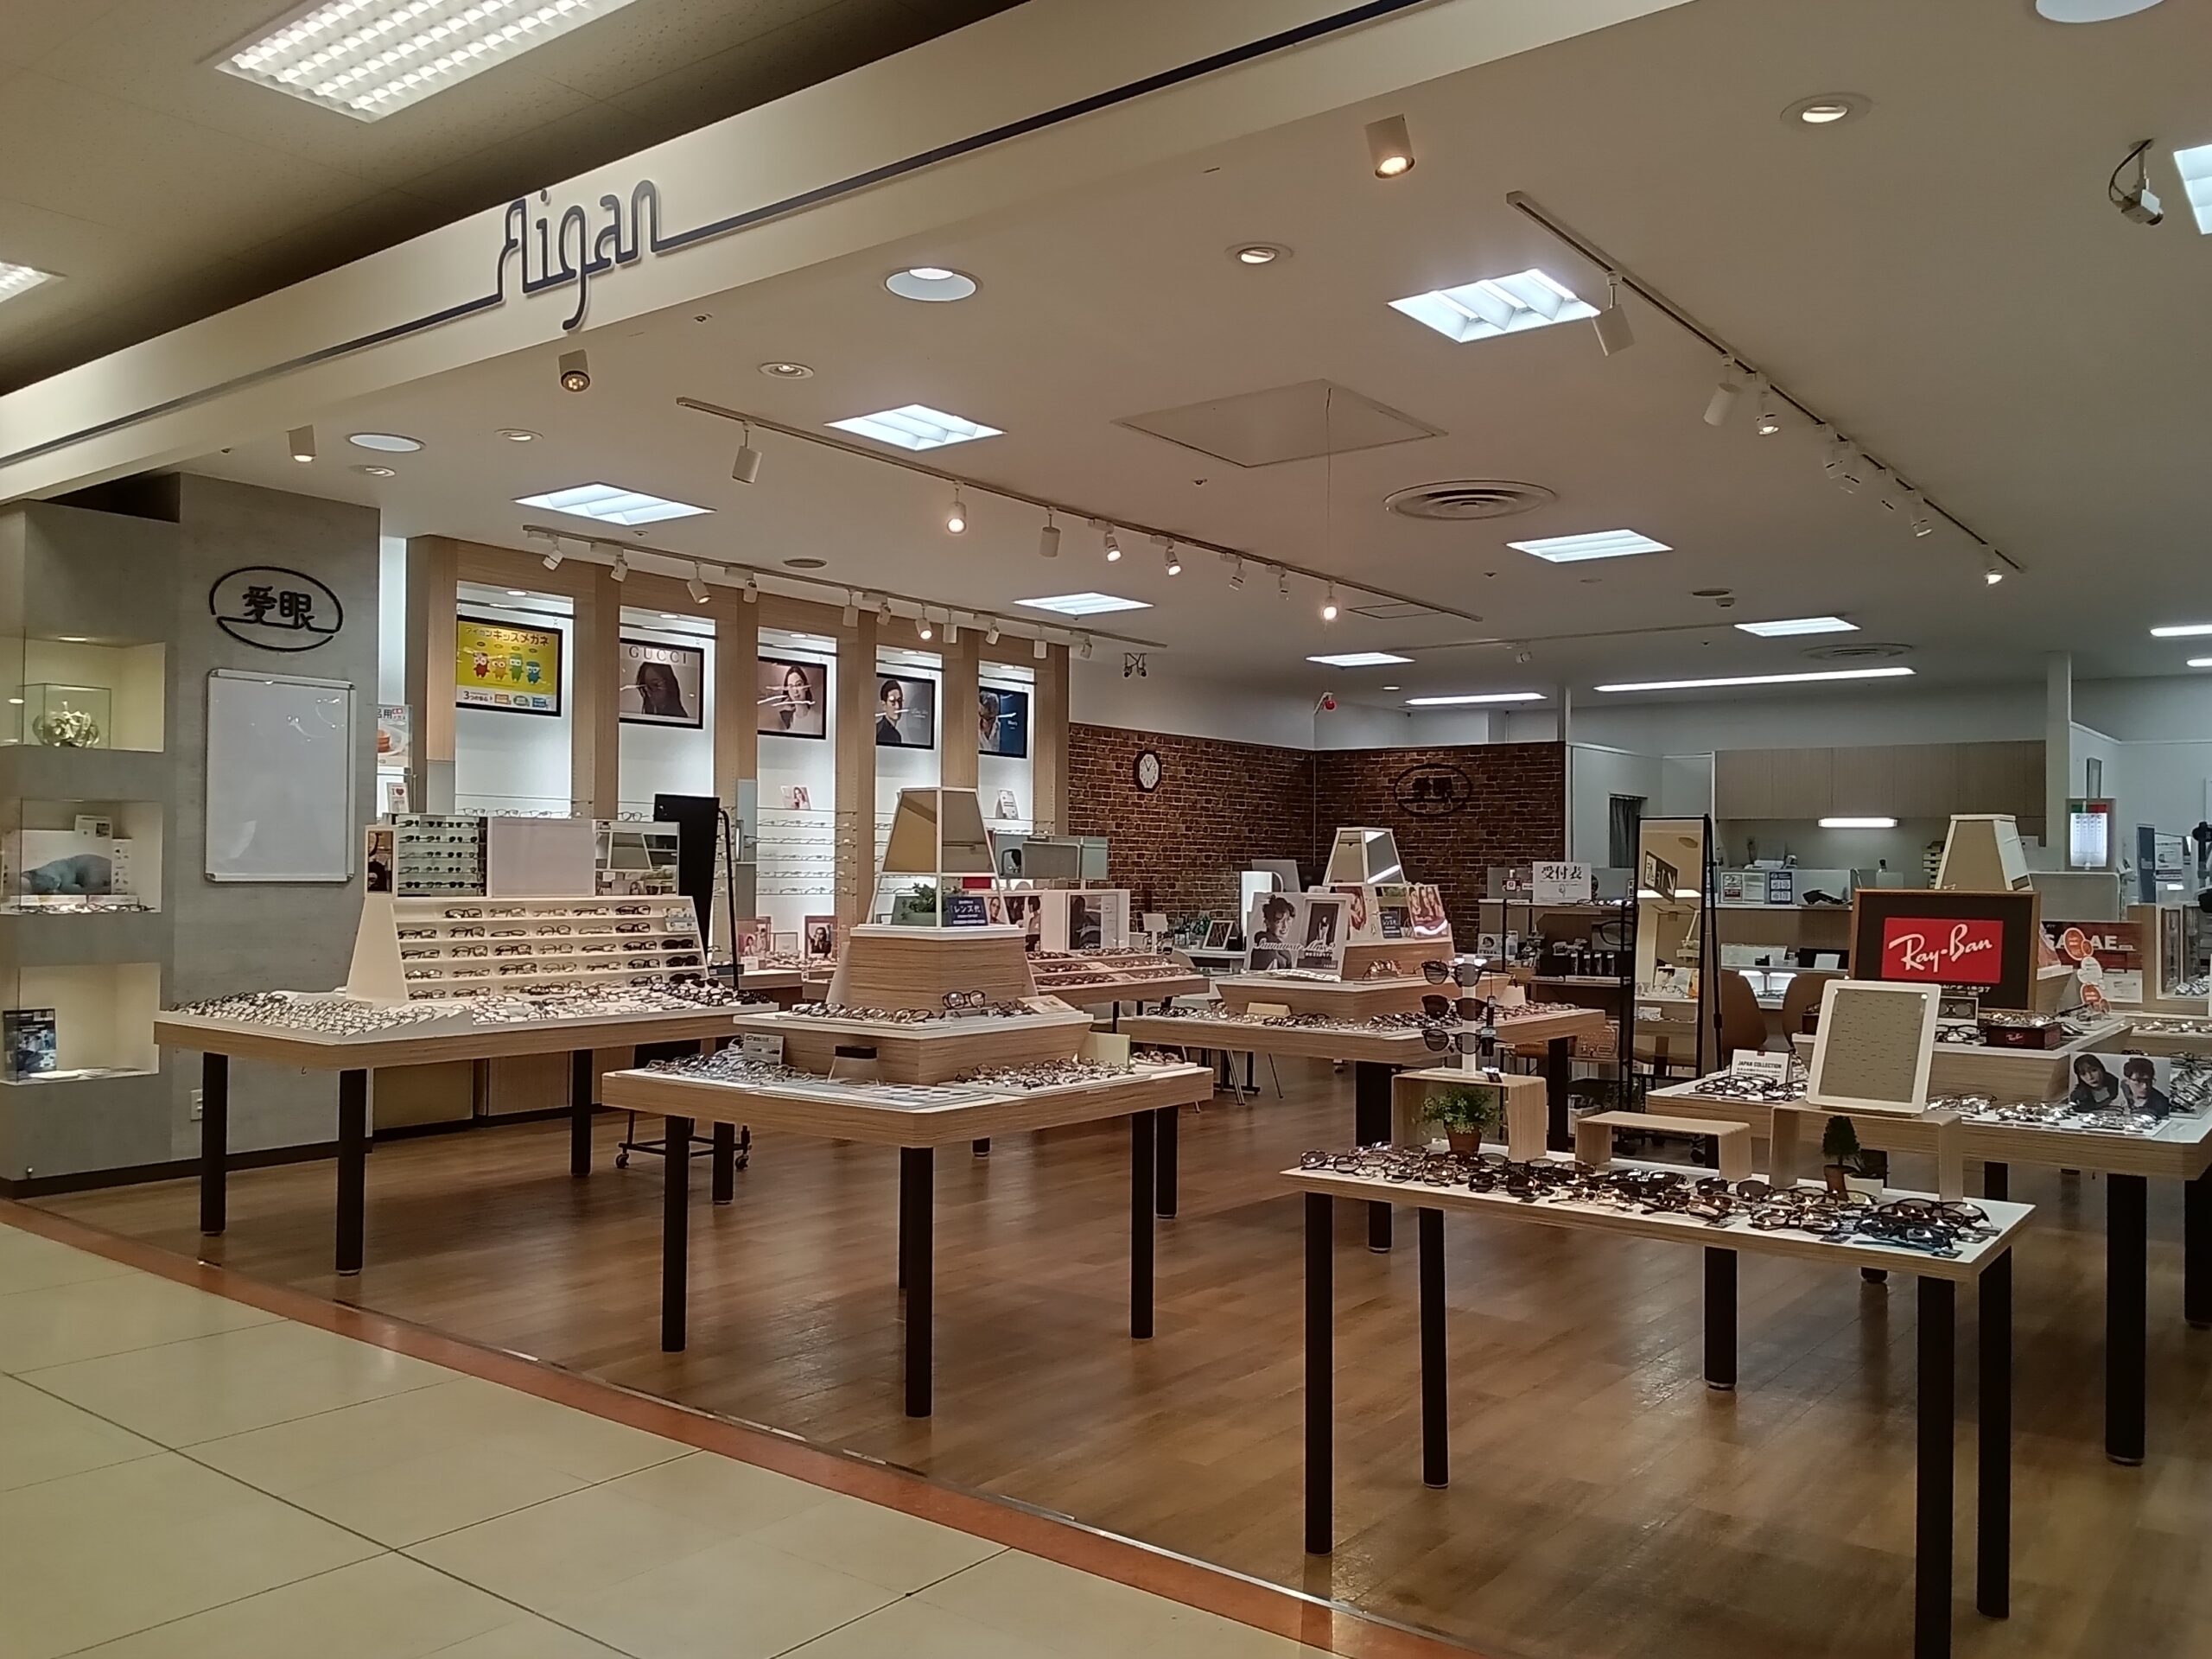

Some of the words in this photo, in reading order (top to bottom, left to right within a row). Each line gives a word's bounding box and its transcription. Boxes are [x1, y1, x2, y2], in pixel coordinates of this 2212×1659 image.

[497, 180, 658, 330] Aigan
[242, 586, 315, 629] 愛眼
[629, 645, 687, 664] GUCCI
[1888, 924, 1993, 973] Ray-Ban
[2044, 934, 2118, 950] SAAE
